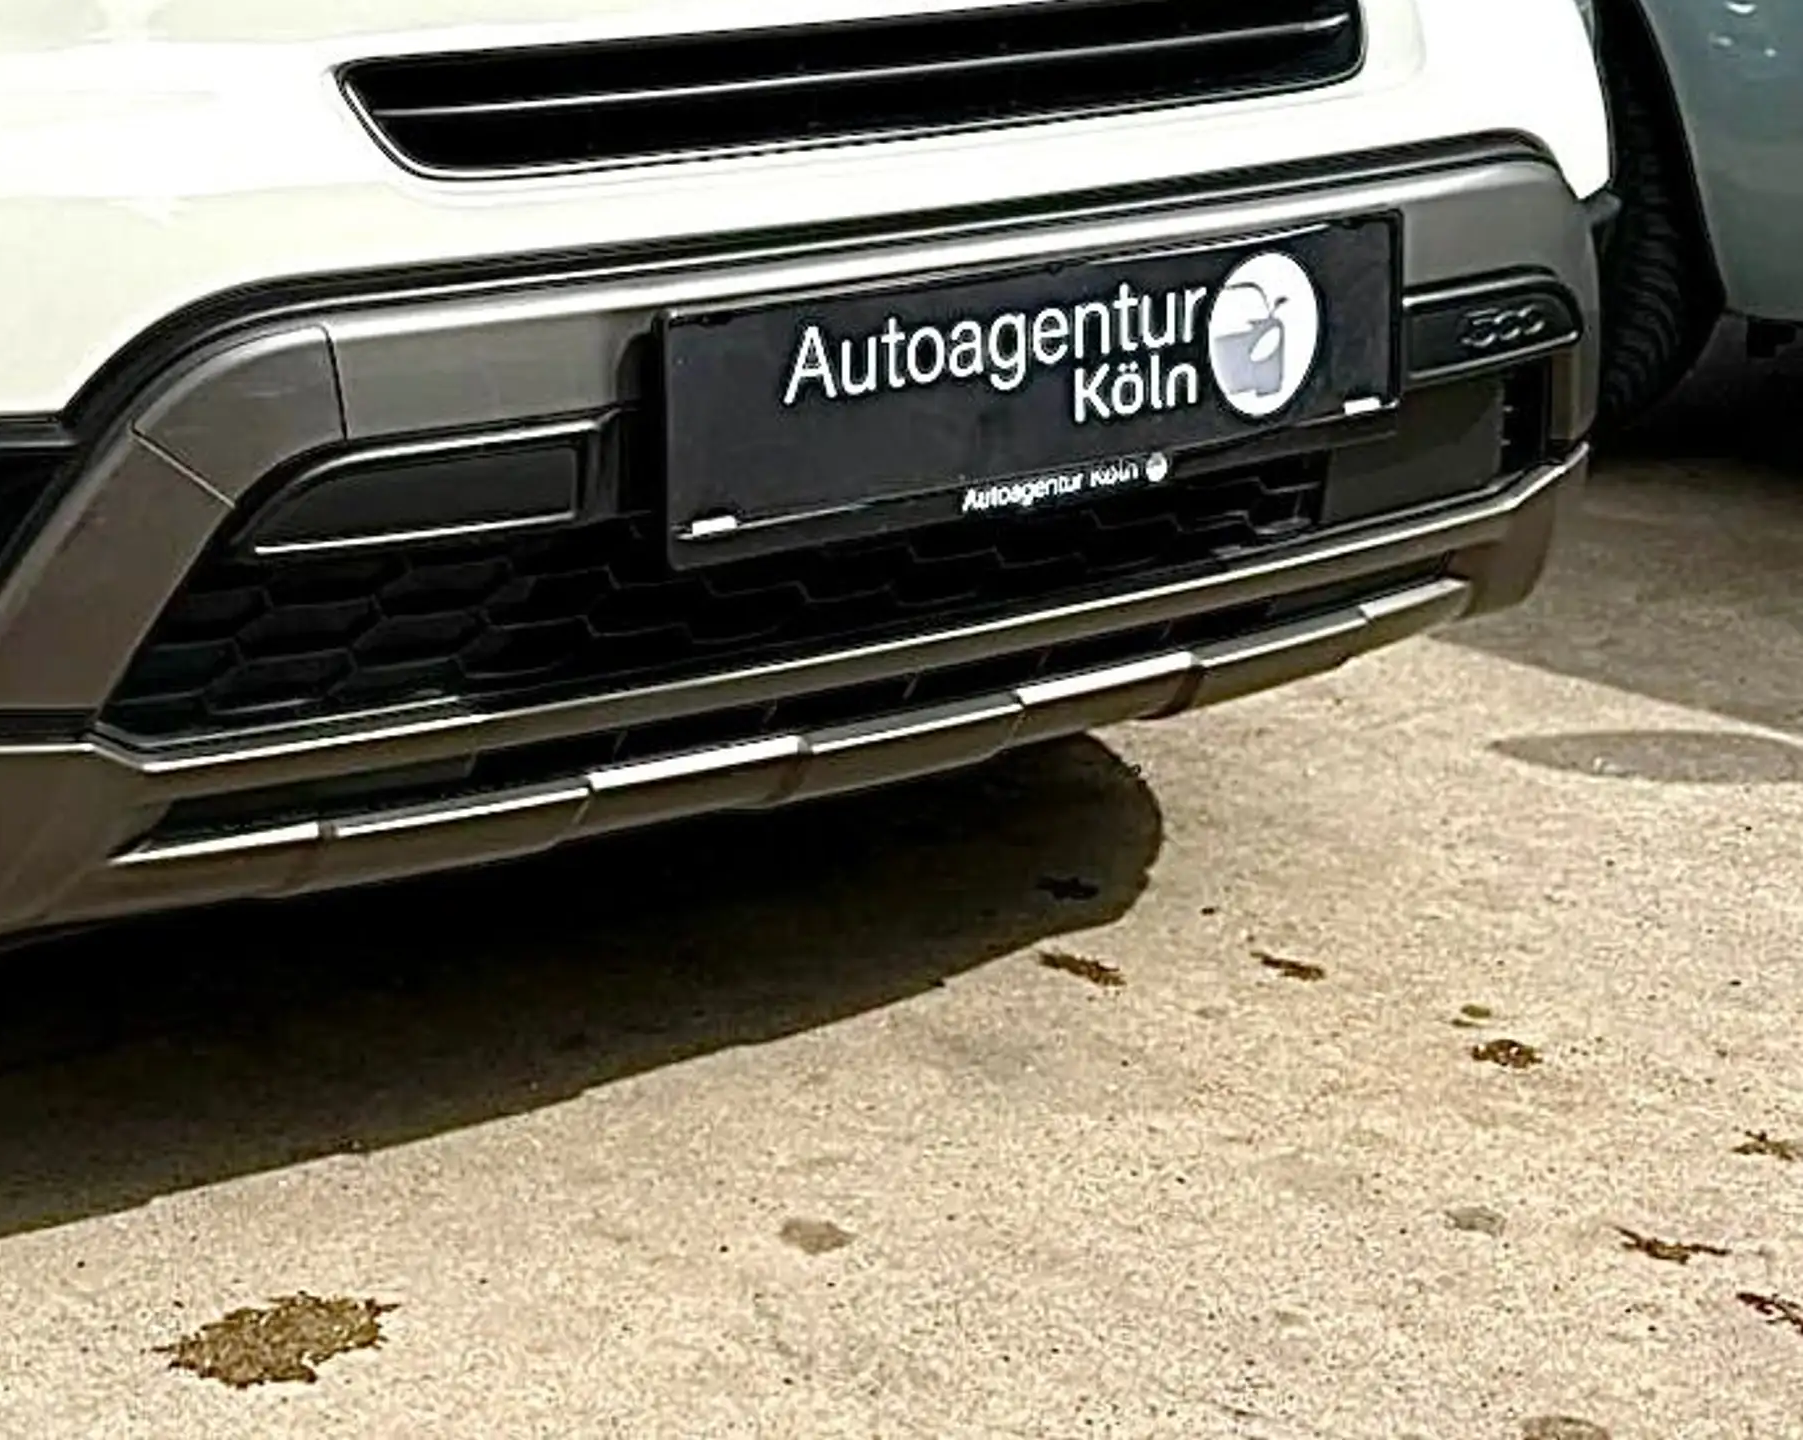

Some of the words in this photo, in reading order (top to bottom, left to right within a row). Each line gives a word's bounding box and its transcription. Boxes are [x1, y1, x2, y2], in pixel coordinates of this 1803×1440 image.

[782, 282, 1207, 406] Autoagentur
[1461, 304, 1547, 347] 500
[1073, 353, 1199, 424] Köln
[961, 471, 1085, 512] Autoagentur
